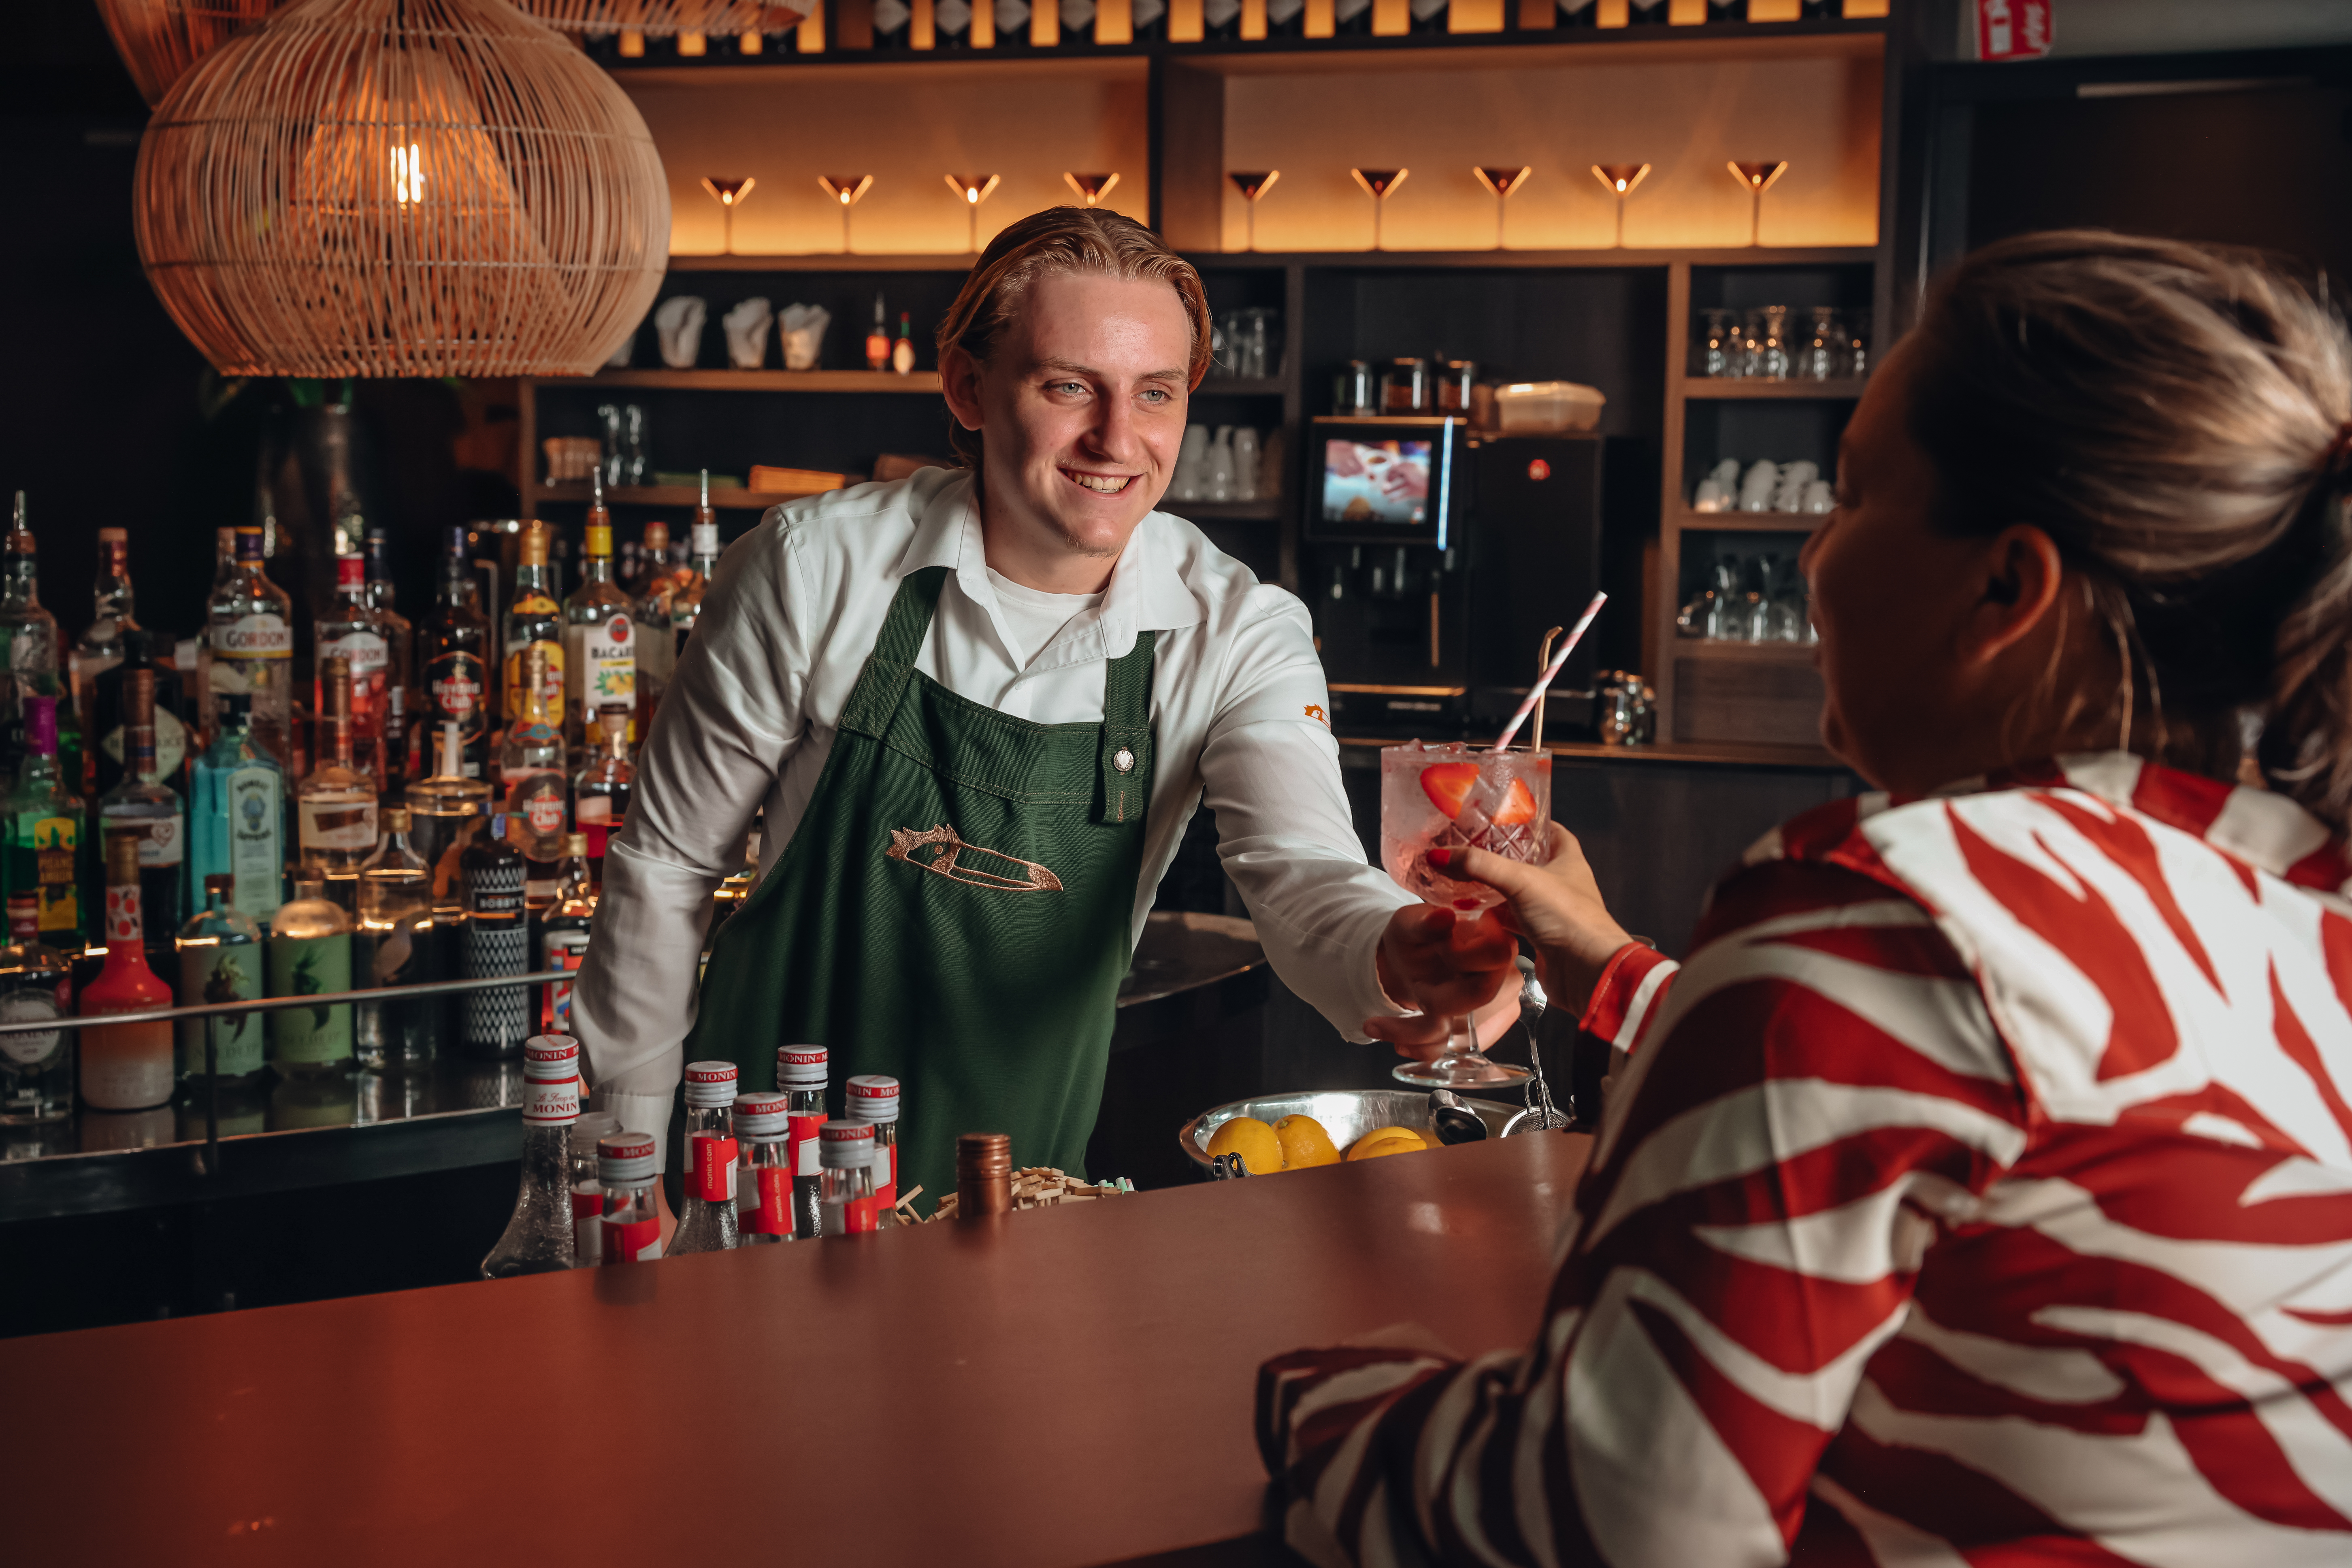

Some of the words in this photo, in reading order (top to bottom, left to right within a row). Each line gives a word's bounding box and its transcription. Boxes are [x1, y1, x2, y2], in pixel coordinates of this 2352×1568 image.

[779, 1053, 816, 1063] MONIN
[697, 1070, 736, 1082] MONIN
[533, 1101, 577, 1113] MONIN
[755, 1100, 788, 1113] MONI
